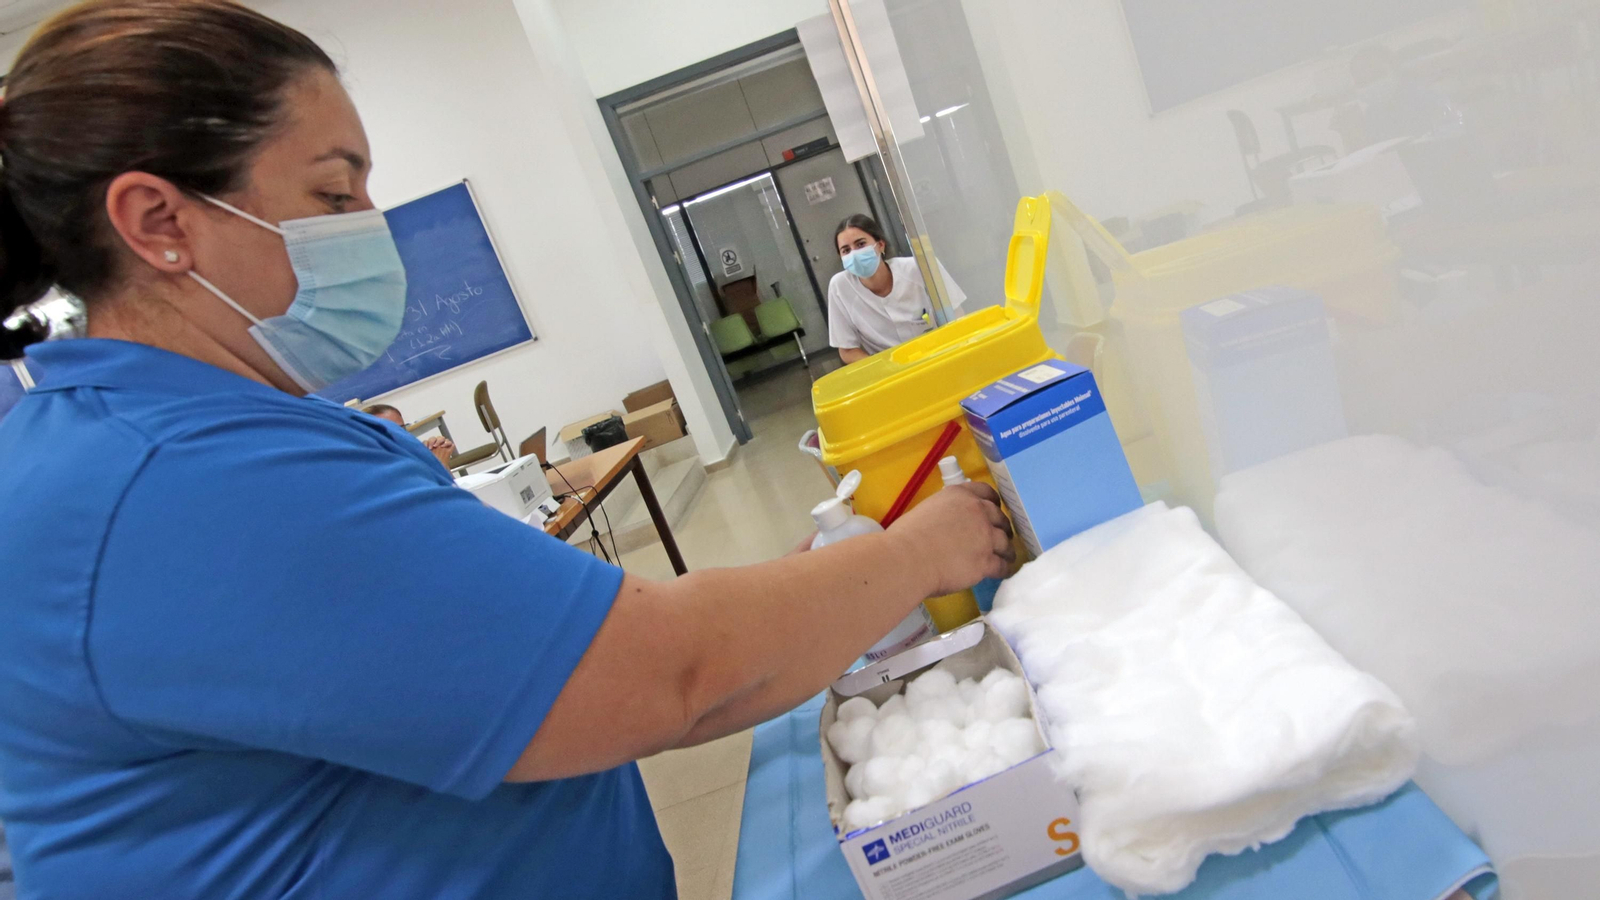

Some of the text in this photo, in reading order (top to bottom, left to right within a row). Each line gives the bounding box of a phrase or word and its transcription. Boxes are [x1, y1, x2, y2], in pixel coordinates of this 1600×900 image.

[435, 281, 483, 315] Agosto
[1000, 428, 1012, 439] Agua
[1012, 424, 1022, 435] para
[1022, 410, 1051, 430] preparaciones
[1019, 424, 1040, 438] disolvente
[1040, 418, 1051, 429] para
[1059, 405, 1081, 420] parenteral
[889, 801, 972, 844] MEDIGUARD
[893, 813, 975, 855] SPECIAL NITRILE
[1047, 817, 1080, 856] S
[873, 823, 991, 878] NITRILE POWDER-FREE EXAM GLOVES
